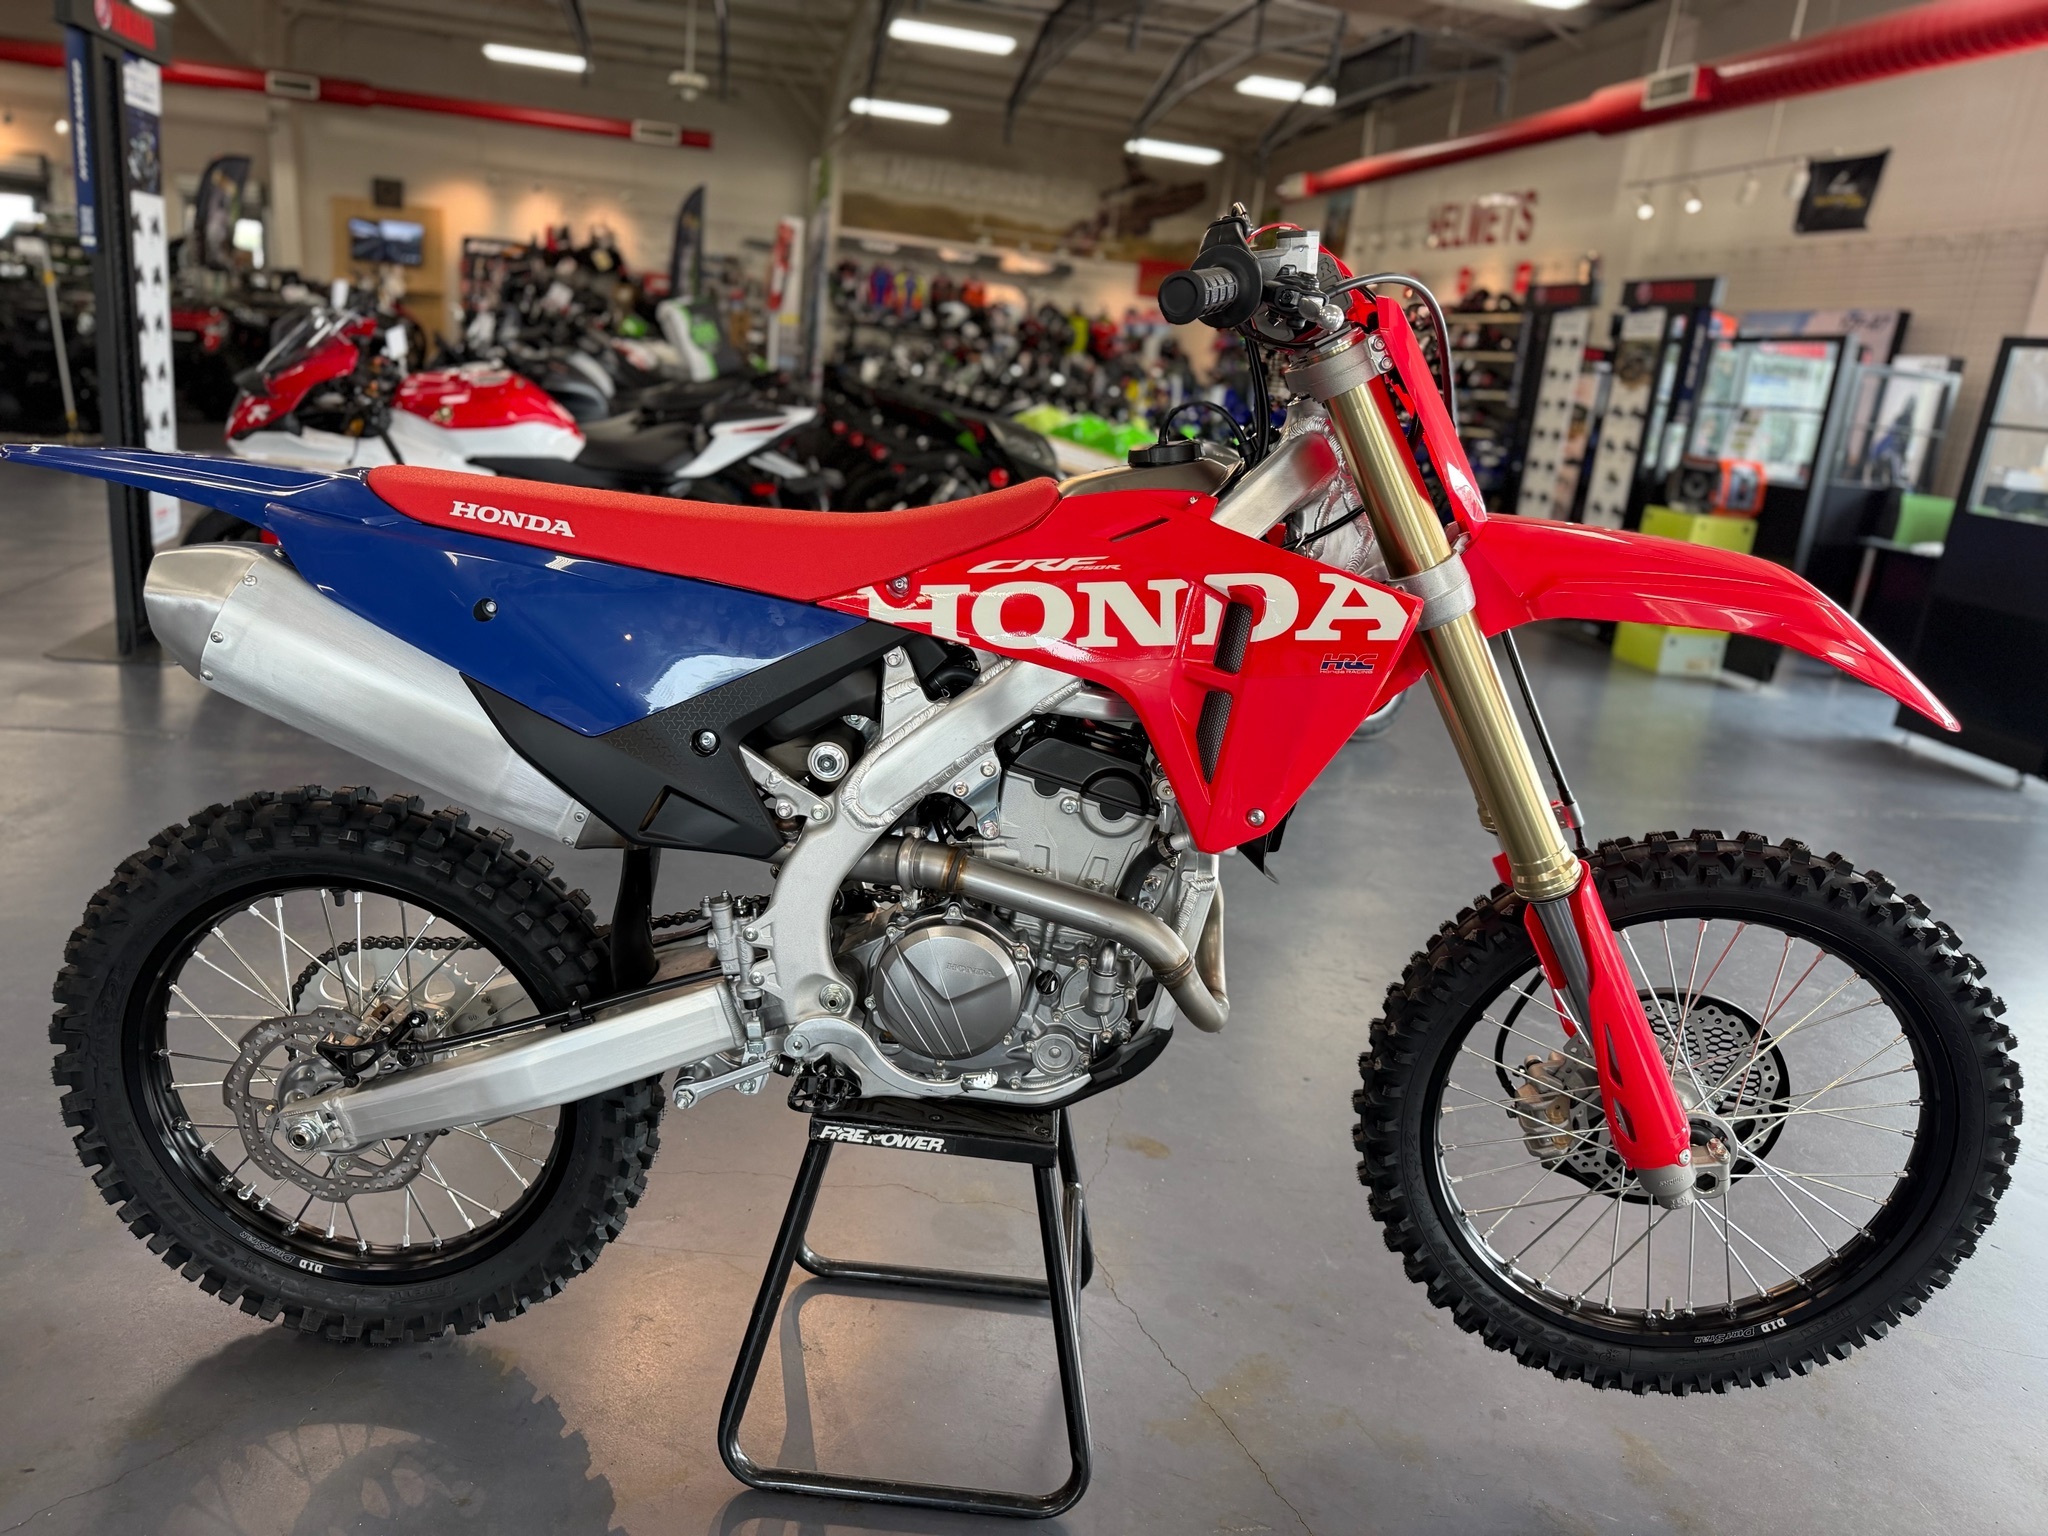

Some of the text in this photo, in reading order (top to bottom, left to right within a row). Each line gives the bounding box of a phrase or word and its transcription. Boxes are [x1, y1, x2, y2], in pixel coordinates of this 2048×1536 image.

[450, 500, 576, 538] HONDA
[967, 556, 1110, 573] CRF
[857, 572, 1410, 650] HONDA
[1320, 653, 1379, 671] HRC
[946, 962, 996, 979] HONDA
